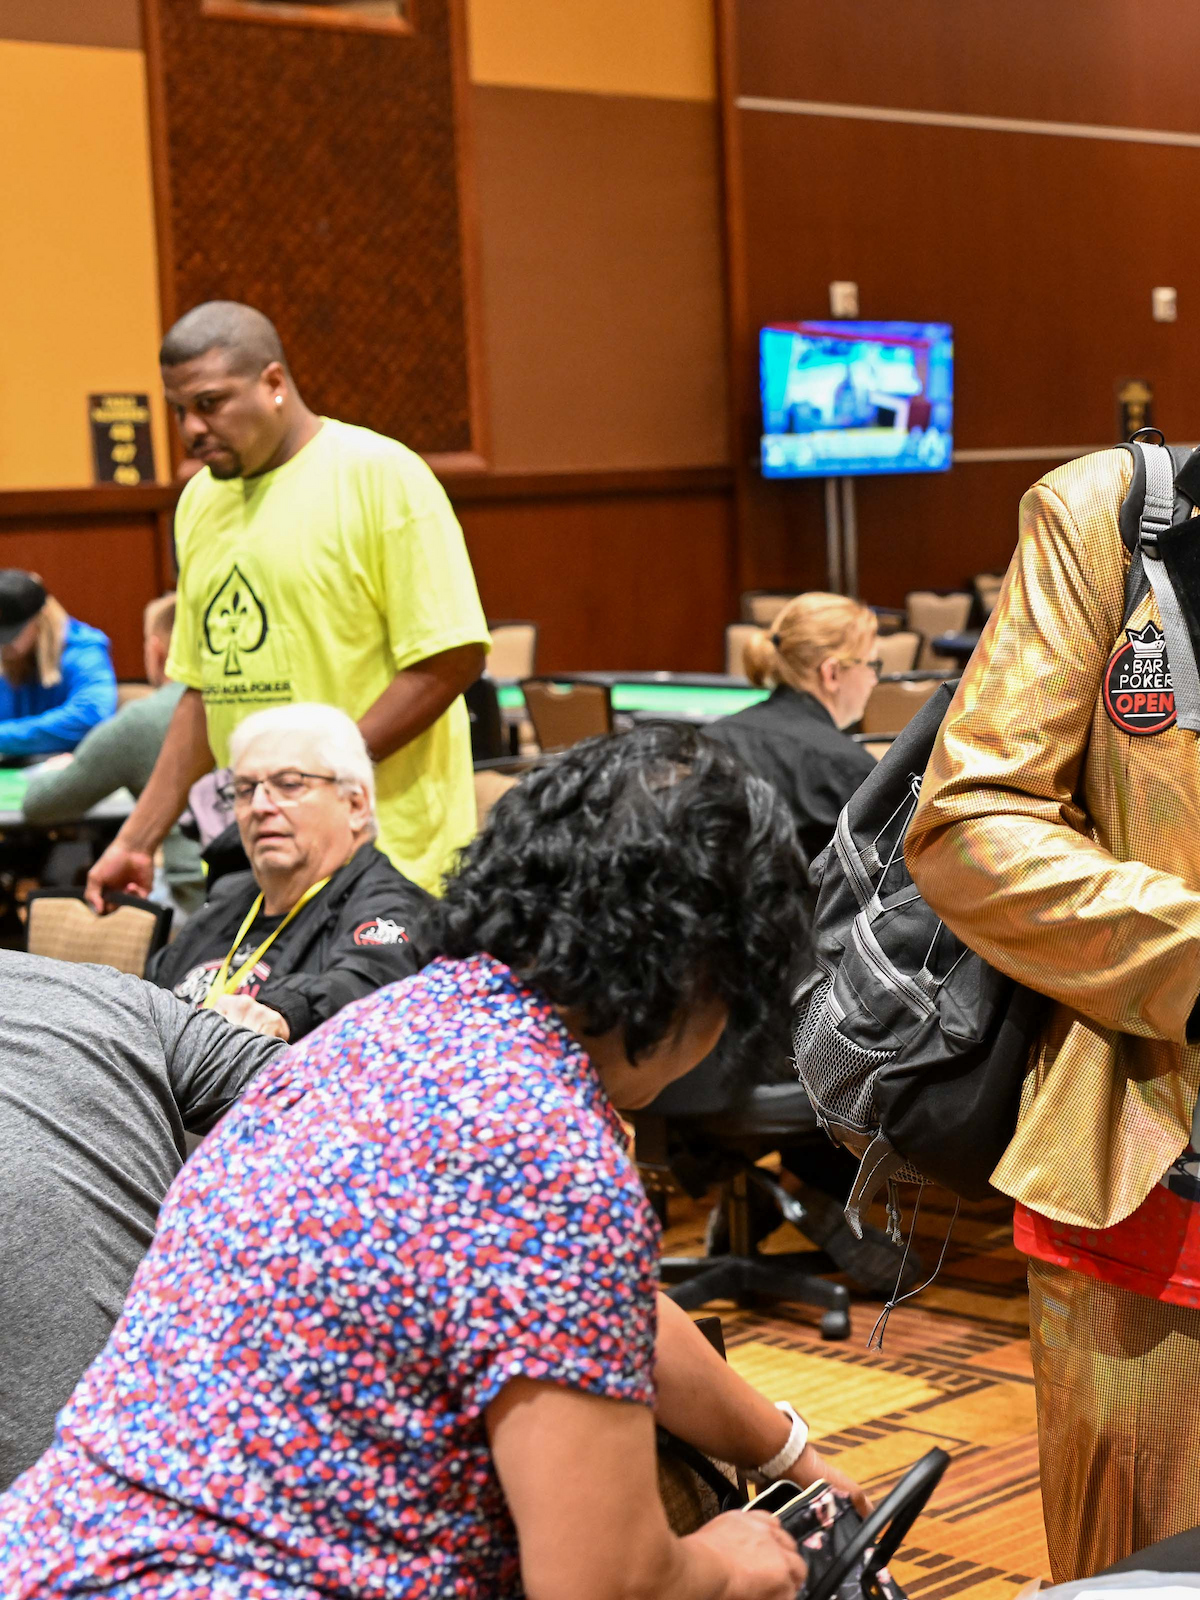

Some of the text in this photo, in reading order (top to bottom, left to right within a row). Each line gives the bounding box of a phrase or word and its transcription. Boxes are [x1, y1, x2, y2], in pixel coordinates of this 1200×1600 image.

[1132, 659, 1163, 674] BAR
[1119, 673, 1174, 689] POKER
[1115, 693, 1175, 714] OPEN
